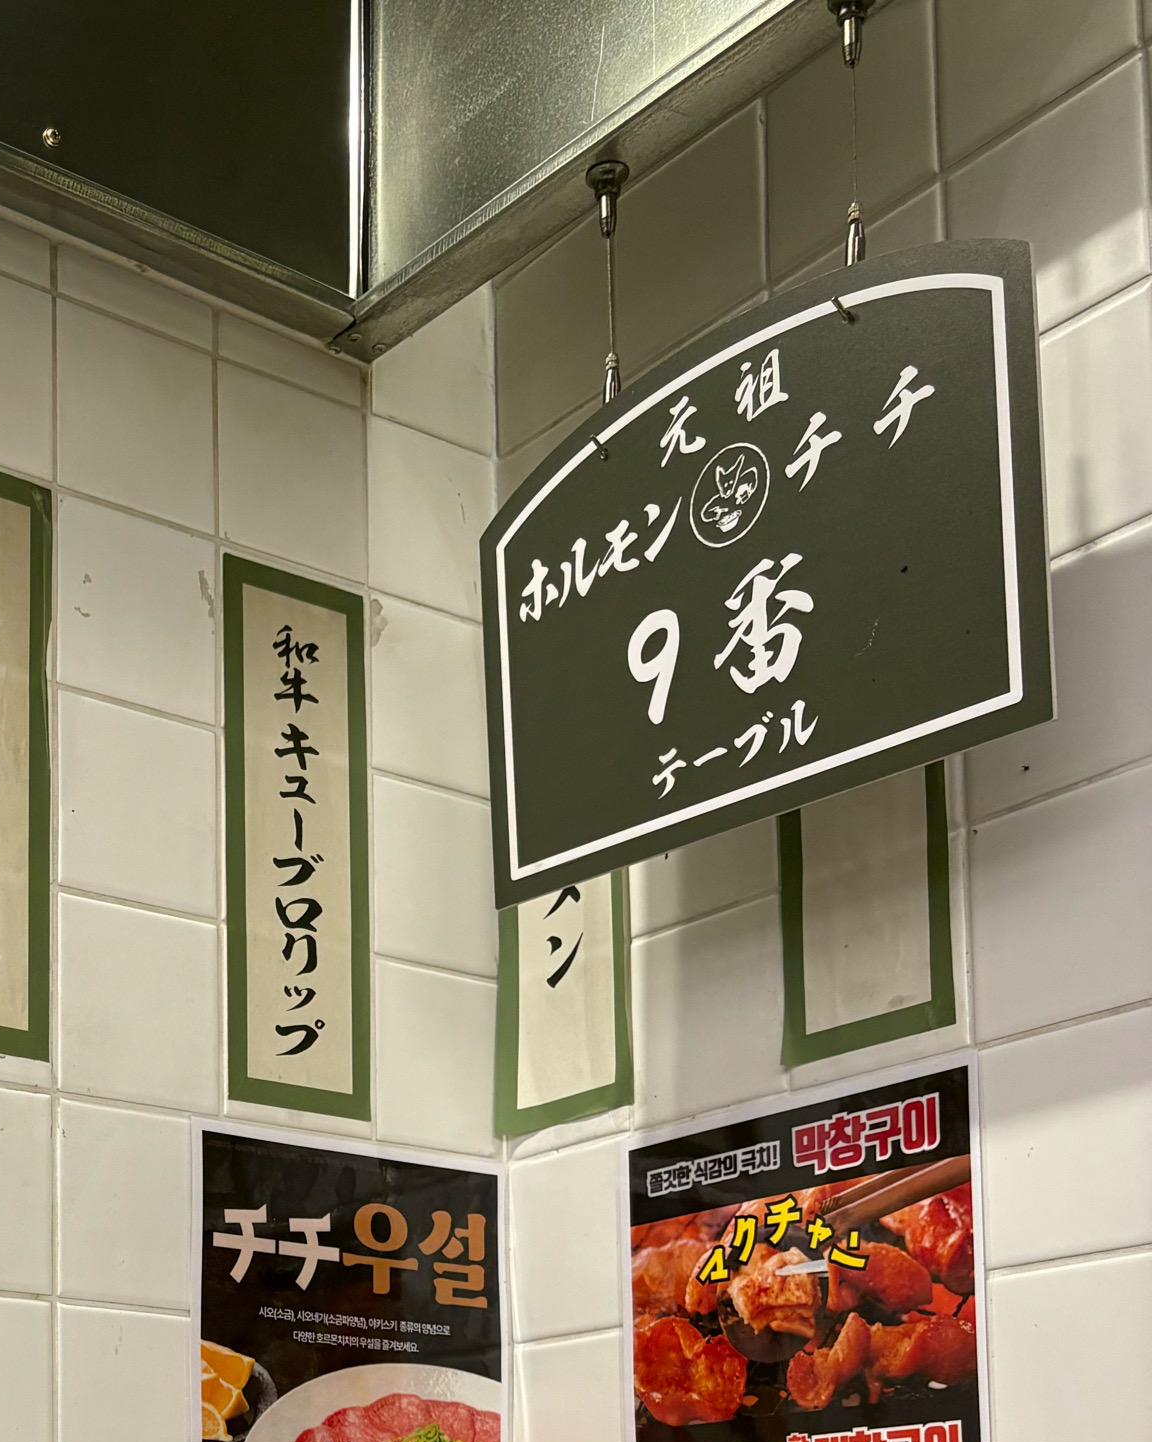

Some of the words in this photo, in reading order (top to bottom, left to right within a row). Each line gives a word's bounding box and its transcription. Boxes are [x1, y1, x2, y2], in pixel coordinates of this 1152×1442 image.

[658, 348, 789, 468] 元祖
[518, 495, 684, 623] ホルモン
[784, 365, 936, 492] チチ
[626, 552, 814, 725] 9番
[650, 699, 820, 799] テーブル
[648, 1165, 693, 1198] 쫄깃한
[693, 1153, 738, 1185] 식감의
[738, 1141, 780, 1174] 극치!
[791, 1092, 941, 1176] 막창구이
[697, 1194, 870, 1286] マクチャン
[258, 1306, 296, 1323] 시오(소금),
[368, 1318, 398, 1332] 야키스키
[399, 1319, 422, 1334] 종류의
[421, 1322, 452, 1336] 양념으로
[292, 1330, 315, 1344] 다양한
[315, 1332, 359, 1349] 호르몬치치의
[359, 1337, 381, 1350] 우설을
[382, 1339, 420, 1354] 즐겨보세요.
